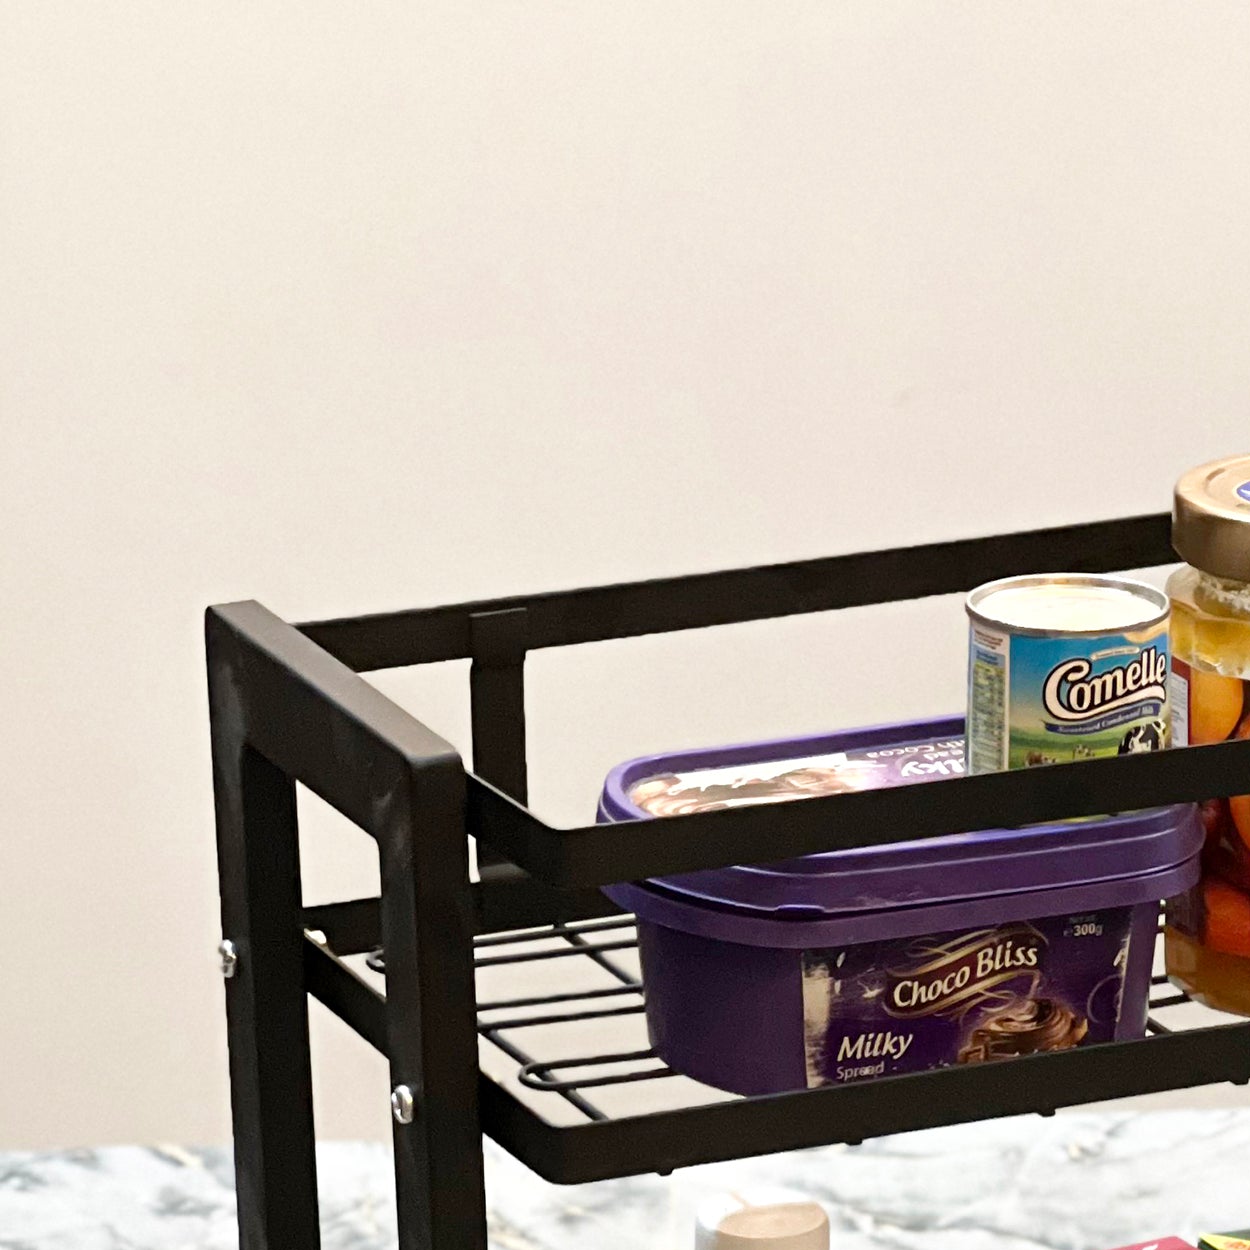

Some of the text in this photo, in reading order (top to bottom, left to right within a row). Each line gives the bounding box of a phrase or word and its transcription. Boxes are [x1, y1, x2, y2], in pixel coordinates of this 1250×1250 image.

[1043, 645, 1167, 720] Comelle
[893, 940, 1039, 1009] Choco Bliss
[836, 1061, 885, 1081] Spread
[837, 1031, 914, 1062] Milky
